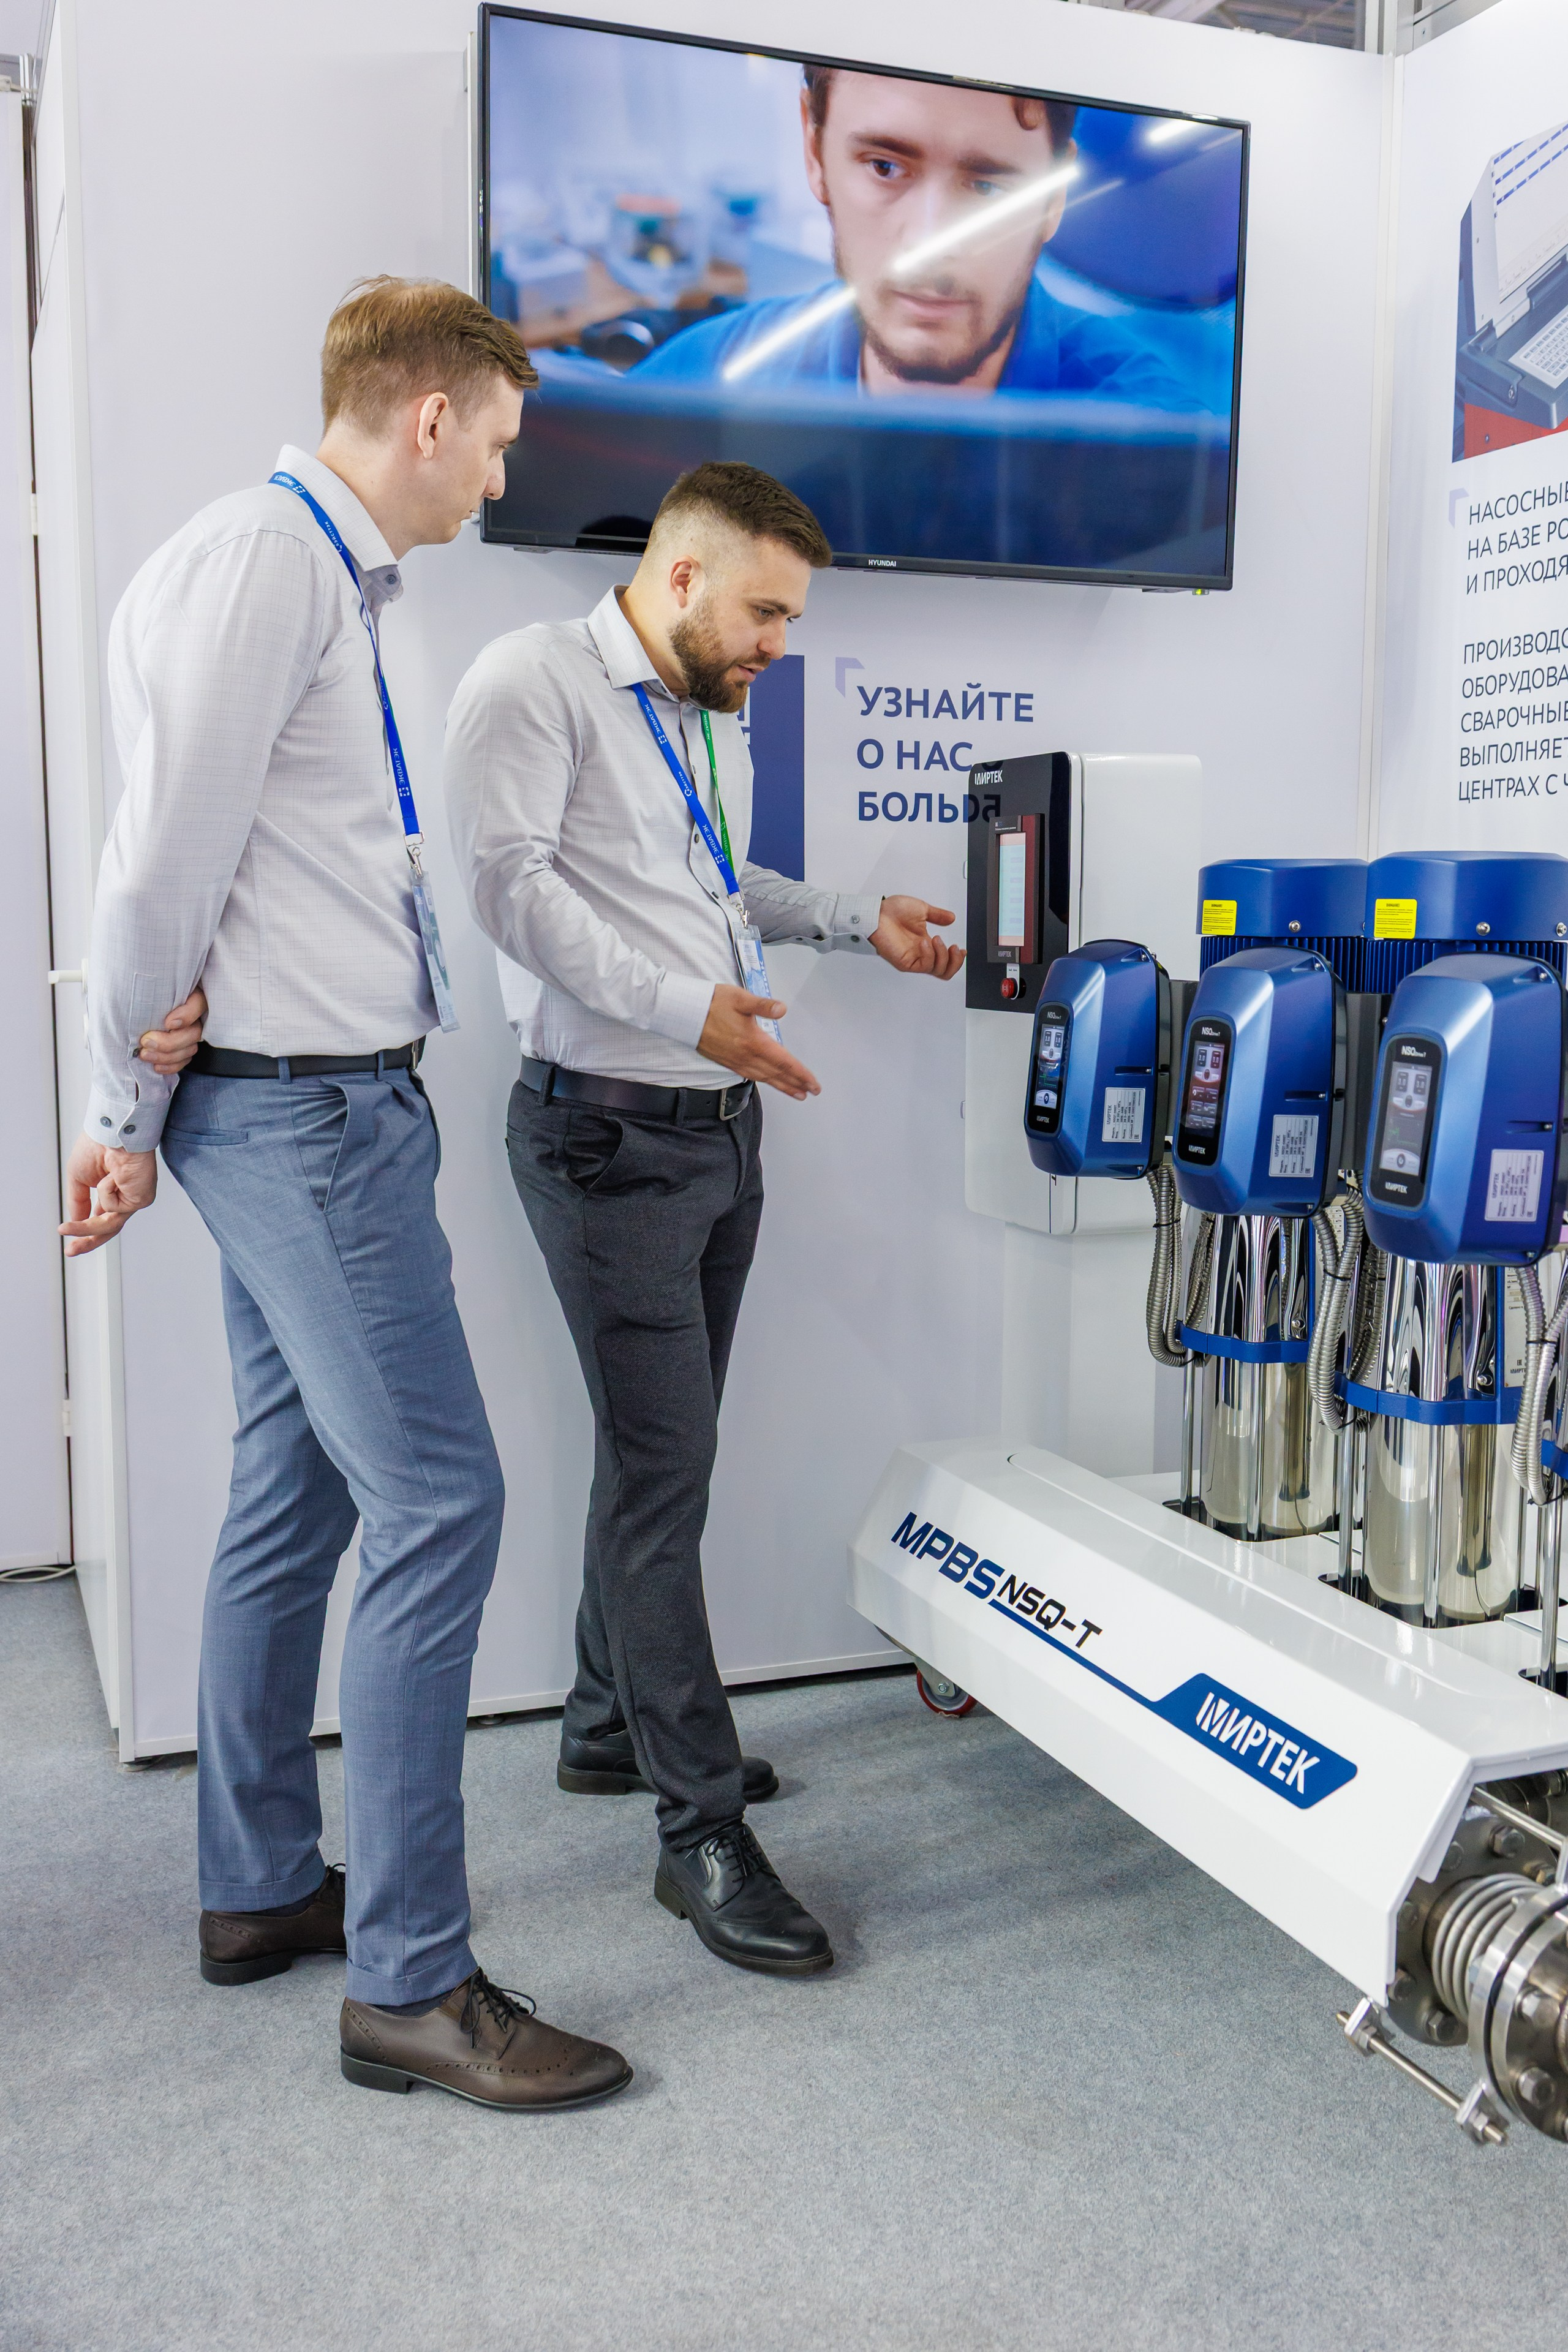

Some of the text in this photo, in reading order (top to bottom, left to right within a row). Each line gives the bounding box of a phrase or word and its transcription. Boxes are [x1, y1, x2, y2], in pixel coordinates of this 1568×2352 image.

[1468, 535, 1493, 560] НА
[1498, 524, 1541, 554] БАЗЕ
[1467, 573, 1478, 595] И
[1462, 664, 1568, 699] ОБОРУДОВА
[644, 703, 662, 734] ЭКВАТЭК
[856, 682, 1034, 723] УЗНАЙТЕ
[392, 747, 405, 785] ЭКВАТЭК
[857, 738, 973, 772] О НАС
[1458, 775, 1540, 804] ЦЕНТРАХ
[1545, 774, 1558, 795] С
[859, 791, 969, 823] БОЛЬ
[702, 824, 720, 854] ЭКВАТЭК
[891, 1511, 1102, 1648] MPBS NSQ-T
[1196, 1691, 1321, 1795] МИРТЕК
